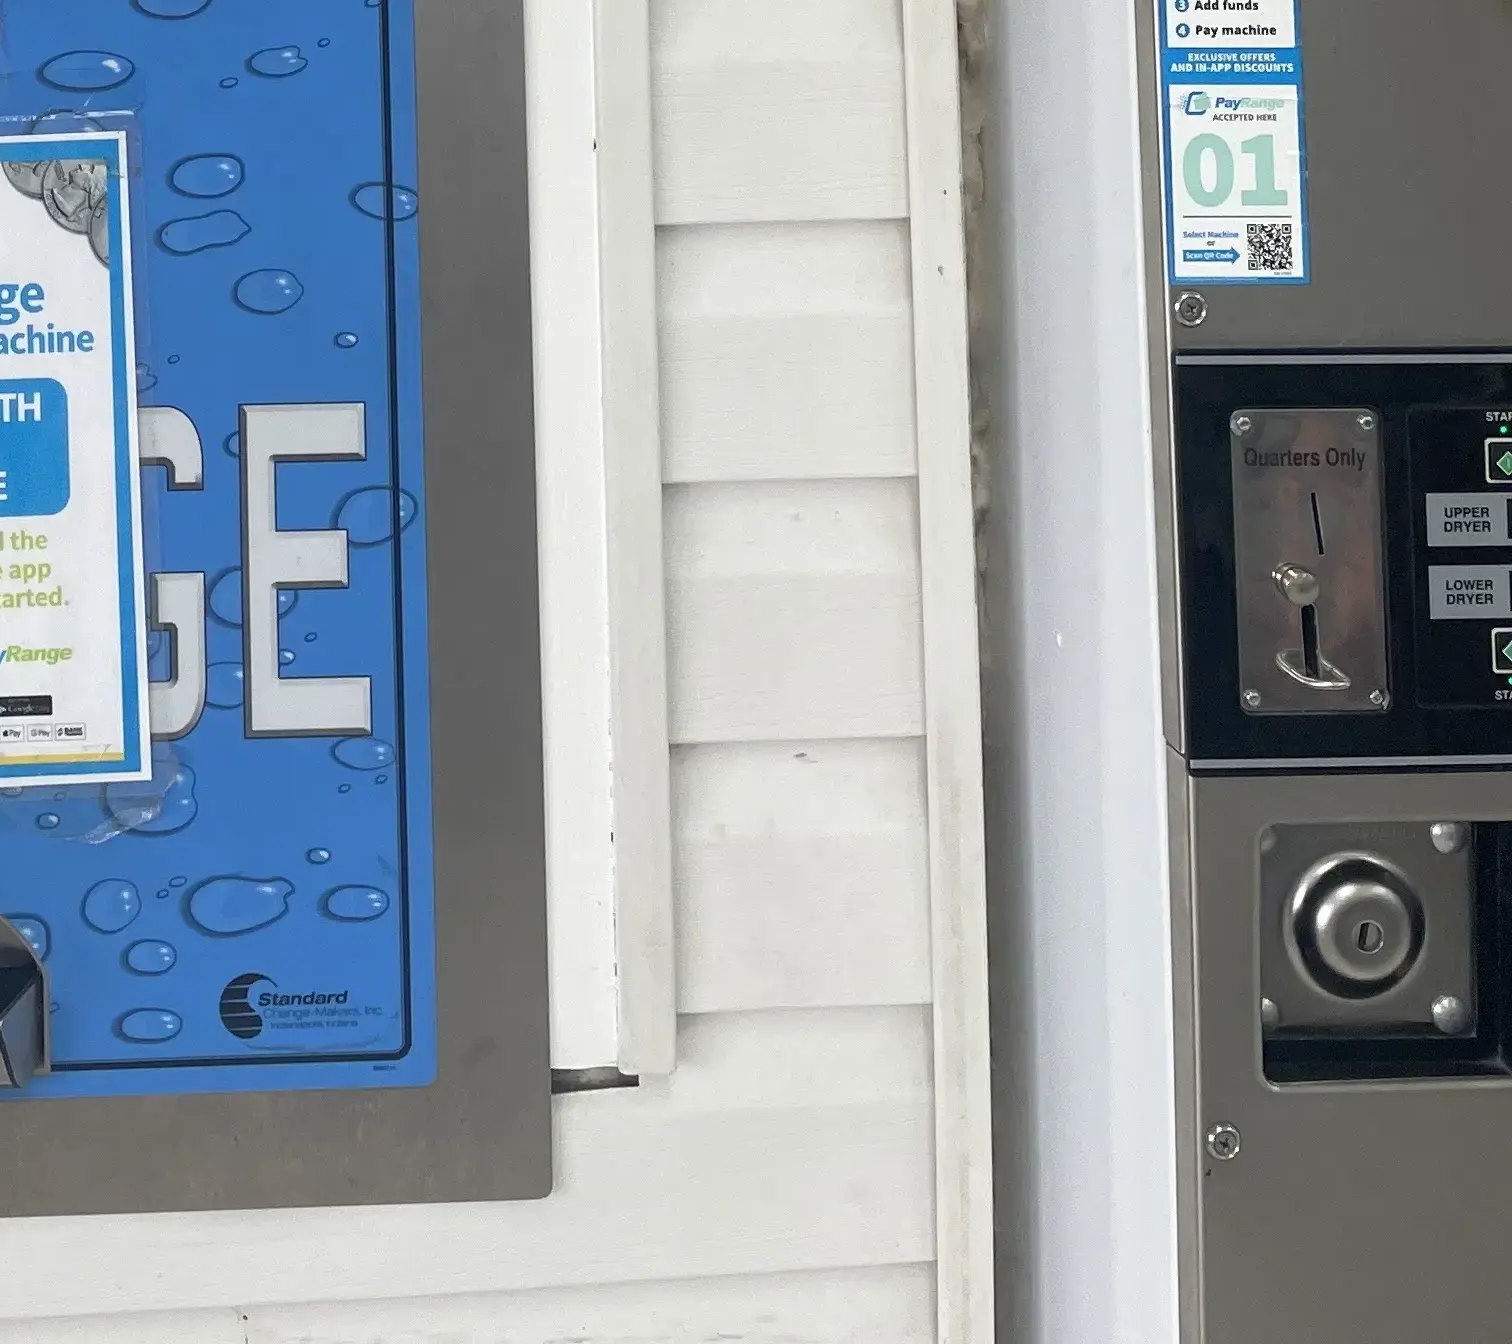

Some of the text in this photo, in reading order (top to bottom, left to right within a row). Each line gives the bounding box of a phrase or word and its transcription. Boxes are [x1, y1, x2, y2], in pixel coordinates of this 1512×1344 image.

[1194, 0, 1218, 11] Add
[1223, 0, 1259, 11] funds
[1195, 25, 1218, 38] Pay
[1222, 24, 1276, 36] machine
[1188, 52, 1276, 63] EXCLUSIVE OFFERS
[1233, 62, 1293, 73] DISCOUNTS
[1182, 133, 1288, 208] 01
[1244, 448, 1366, 471] Quarters Only
[1444, 507, 1489, 518] UPPER
[1444, 521, 1491, 533] DRYER
[10, 531, 47, 550] the
[9, 562, 51, 583] app
[1446, 579, 1494, 591] LOWER
[1447, 594, 1494, 605] DRYER
[258, 991, 348, 1006] Standard
